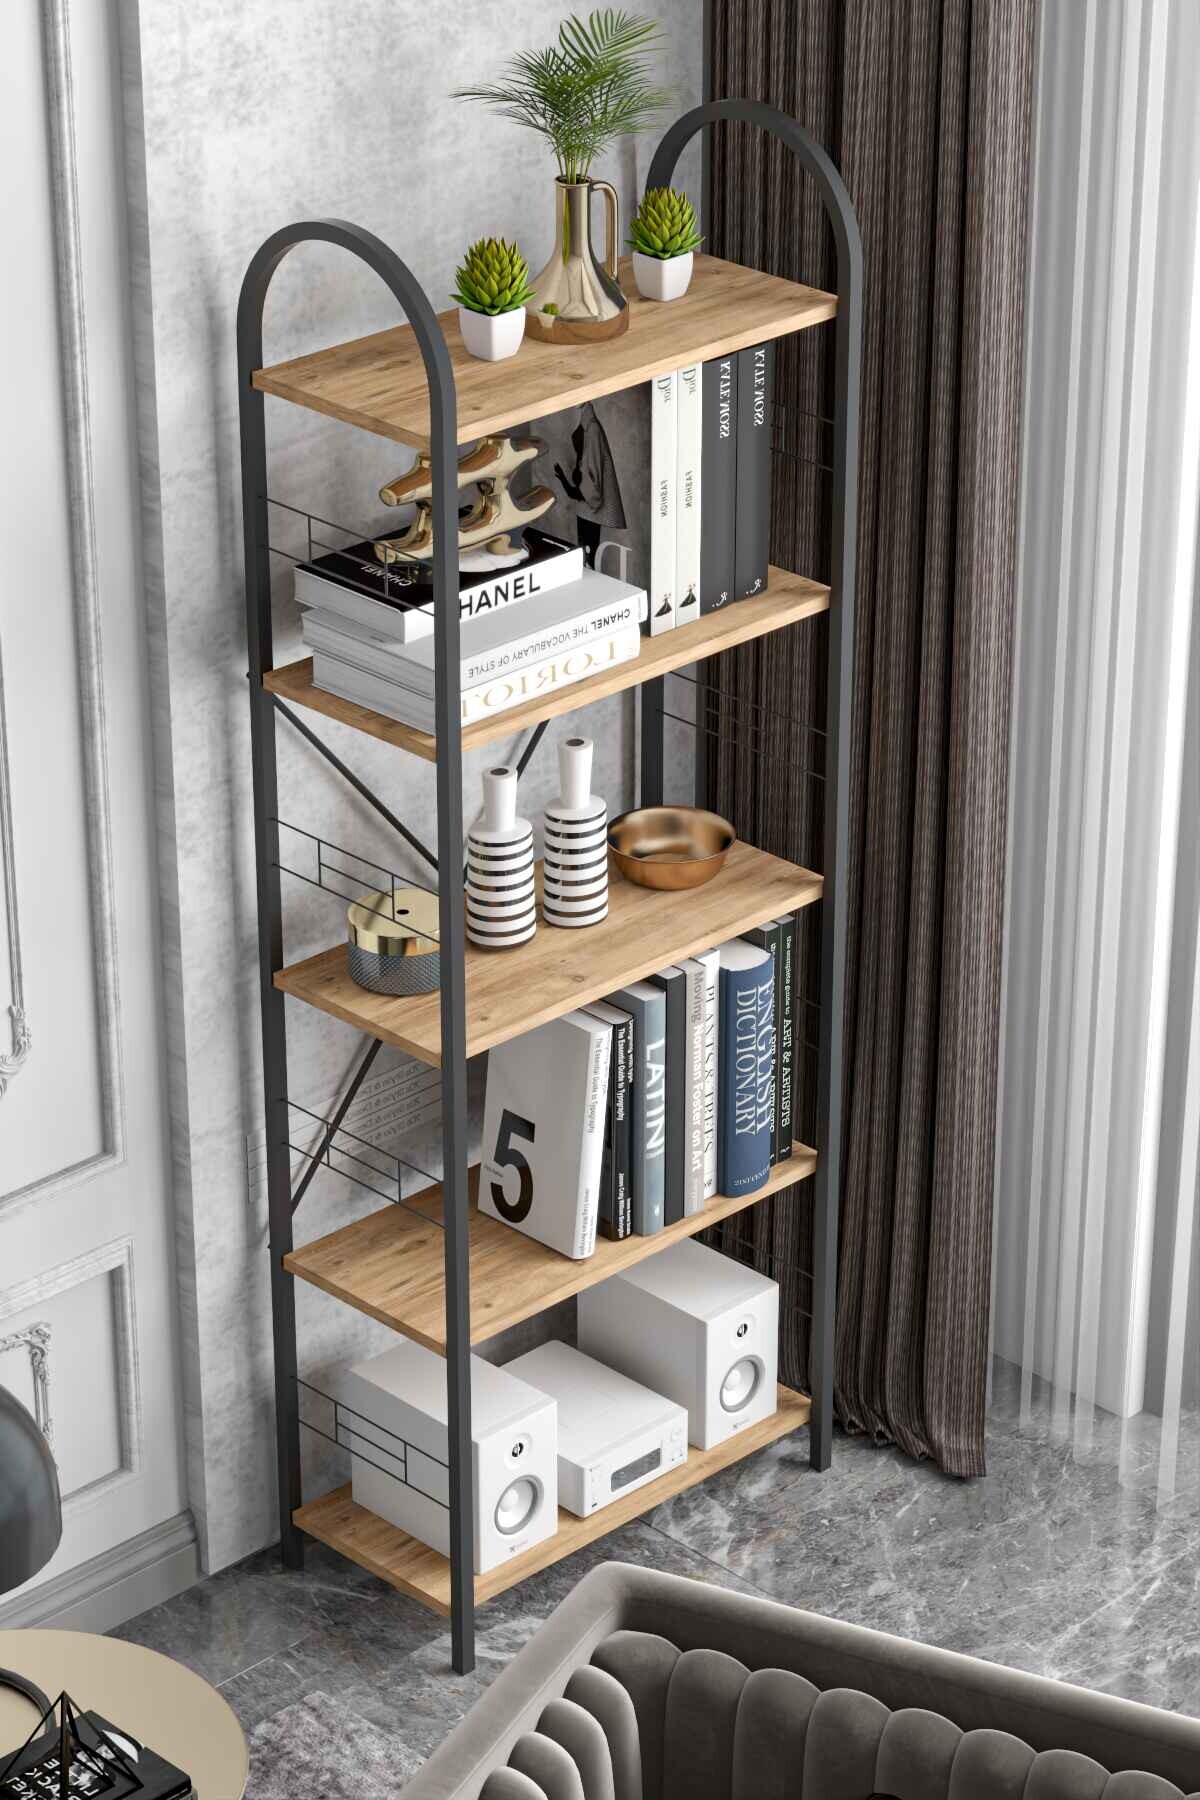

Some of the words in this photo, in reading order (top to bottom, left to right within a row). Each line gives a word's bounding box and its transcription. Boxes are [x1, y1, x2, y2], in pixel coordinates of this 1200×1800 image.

[460, 572, 541, 619] HANEL
[573, 624, 589, 639] THE
[591, 608, 631, 630] CHANEL
[512, 631, 570, 659] VOCABULARY
[468, 660, 496, 678] STYLE
[498, 654, 510, 665] OF
[783, 1018, 792, 1047] ART
[693, 1023, 704, 1081] Norman
[736, 987, 757, 1136] DICTIONARY
[757, 976, 774, 1133] ENGLISH
[782, 1050, 791, 1063] &
[692, 1082, 704, 1126] Foster
[781, 1066, 791, 1127] ARTISTS
[692, 1129, 701, 1148] on
[490, 1108, 535, 1223] 5
[692, 1150, 703, 1173] Art
